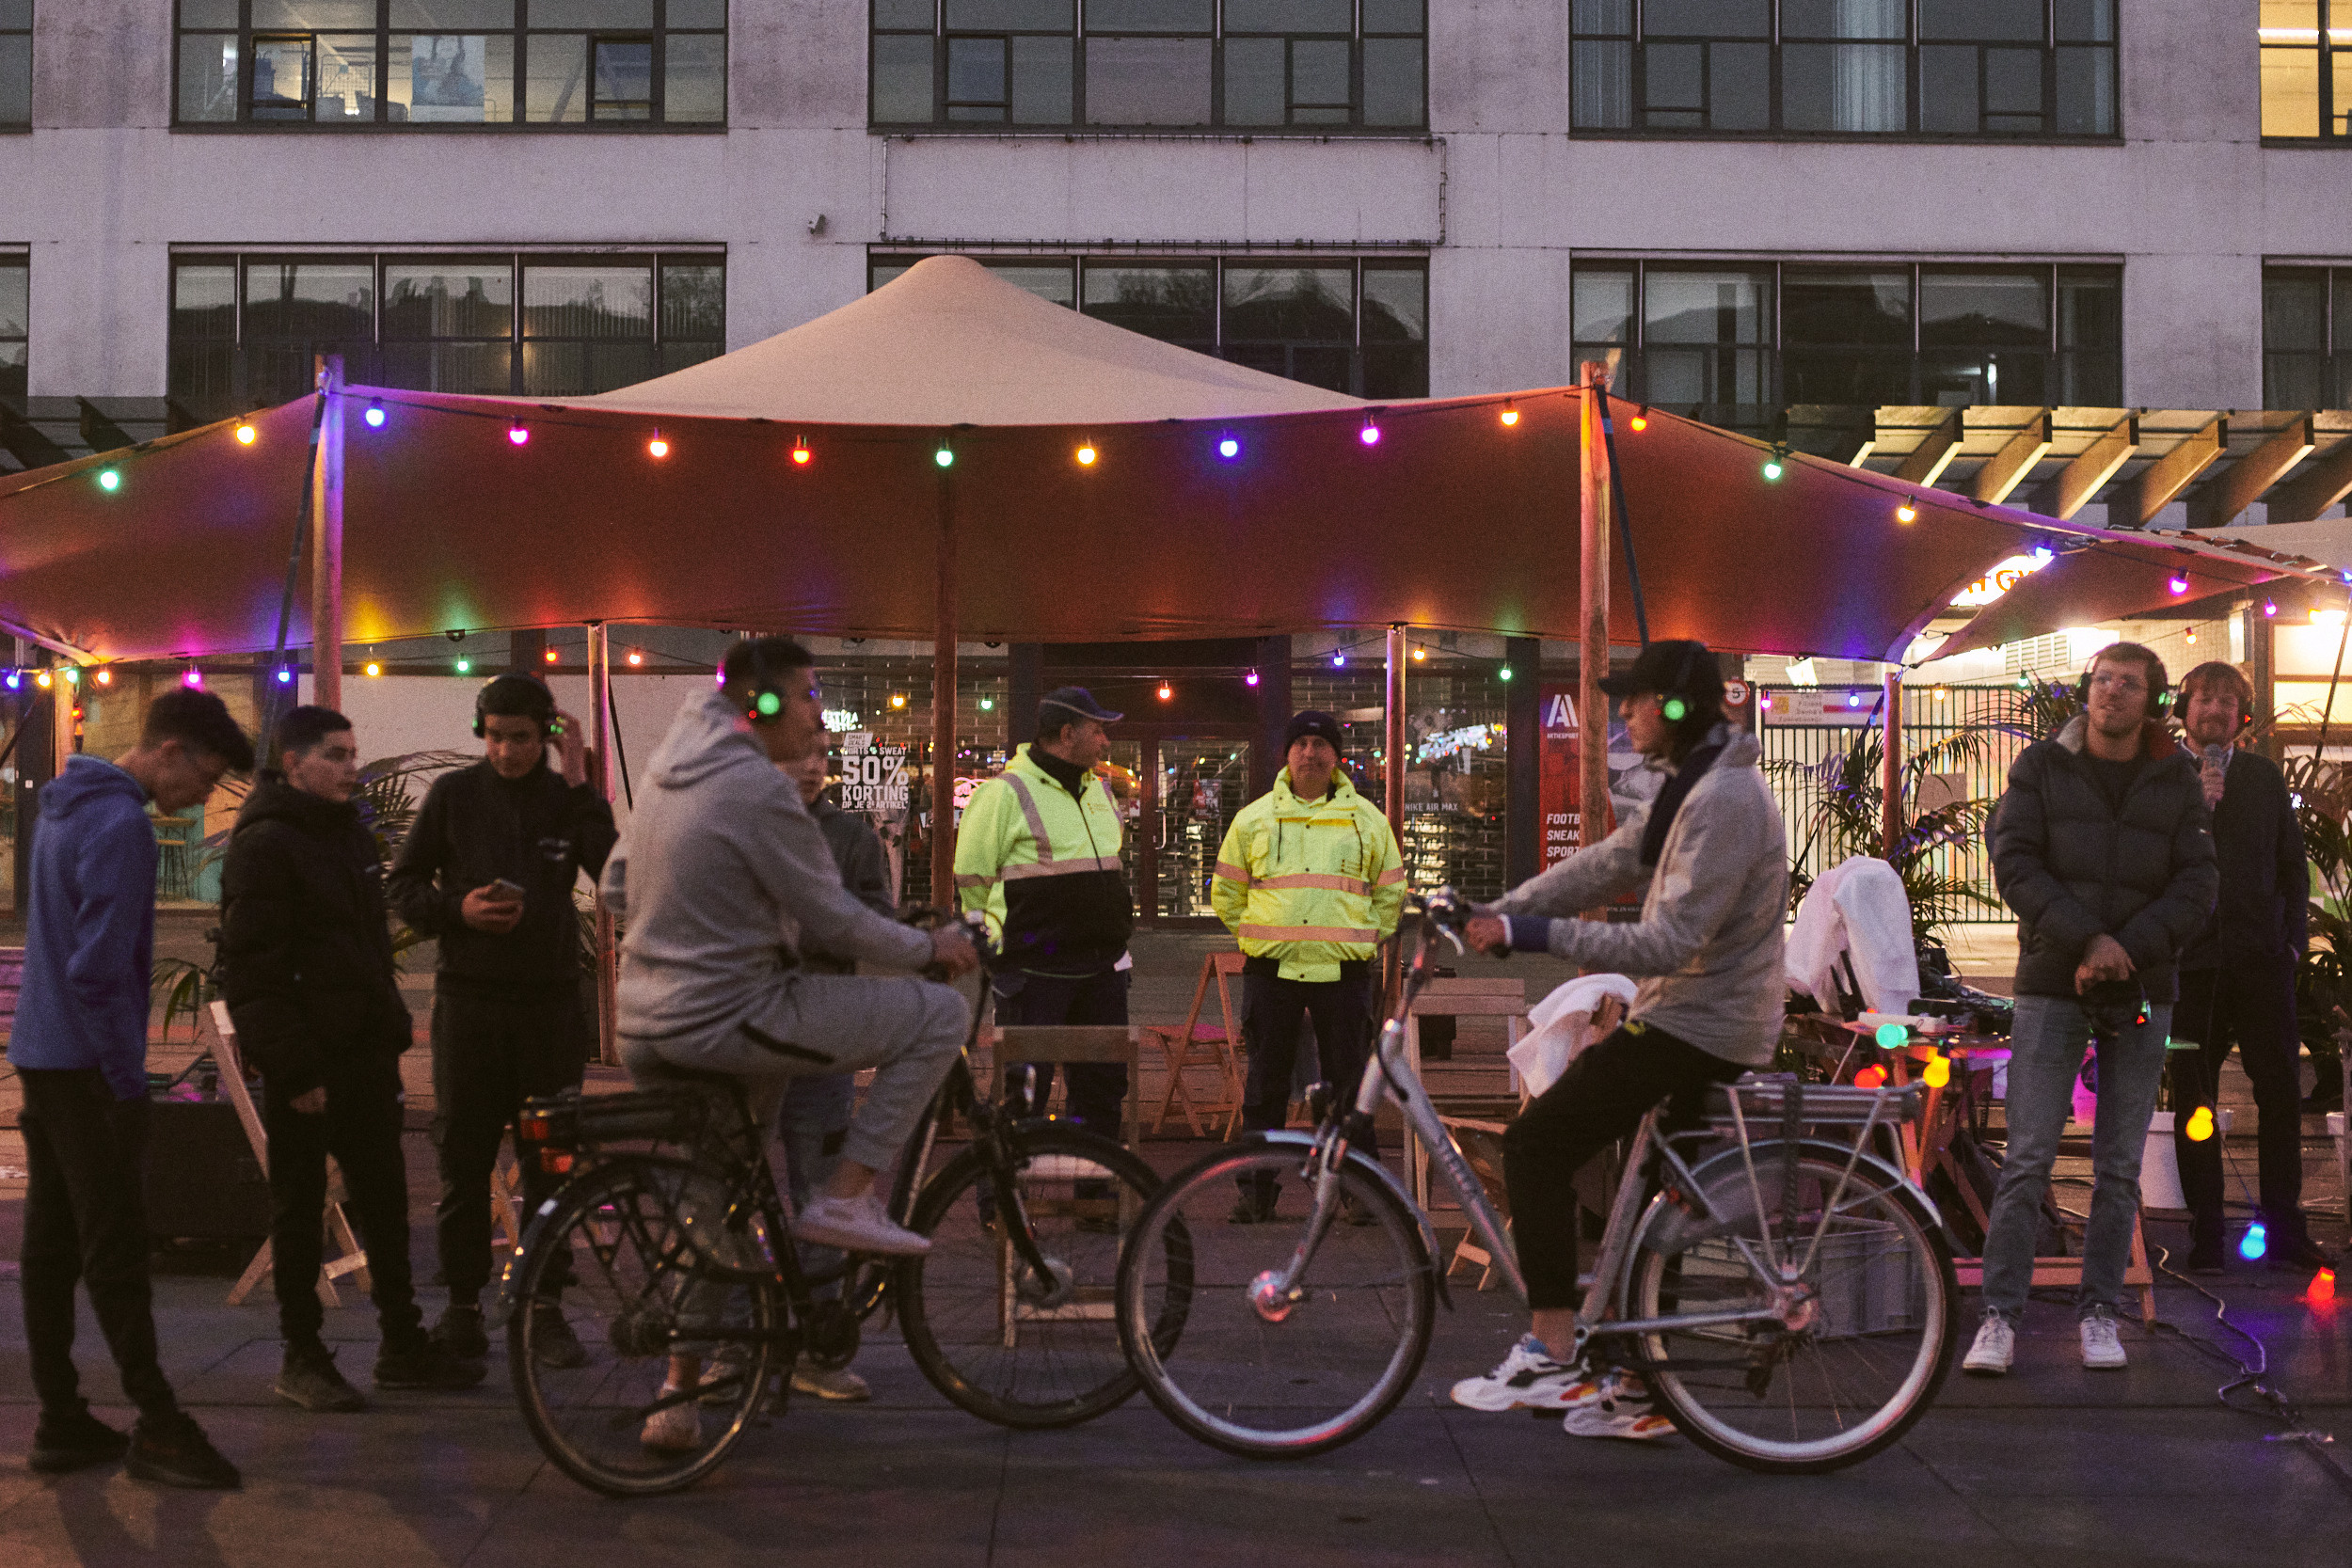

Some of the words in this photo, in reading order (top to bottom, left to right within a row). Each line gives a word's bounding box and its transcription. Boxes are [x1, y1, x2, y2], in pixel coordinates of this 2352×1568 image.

[1732, 688, 1740, 699] 5
[880, 747, 906, 755] SWEAT
[842, 756, 909, 785] 50%
[842, 785, 909, 801] KORTING
[1405, 802, 1423, 811] NIKE
[1426, 802, 1438, 811] AIR
[1441, 802, 1458, 811] MAX
[1547, 814, 1580, 825] FOOTB
[1547, 830, 1580, 841] SNEAK
[1547, 847, 1580, 858] SPORT
